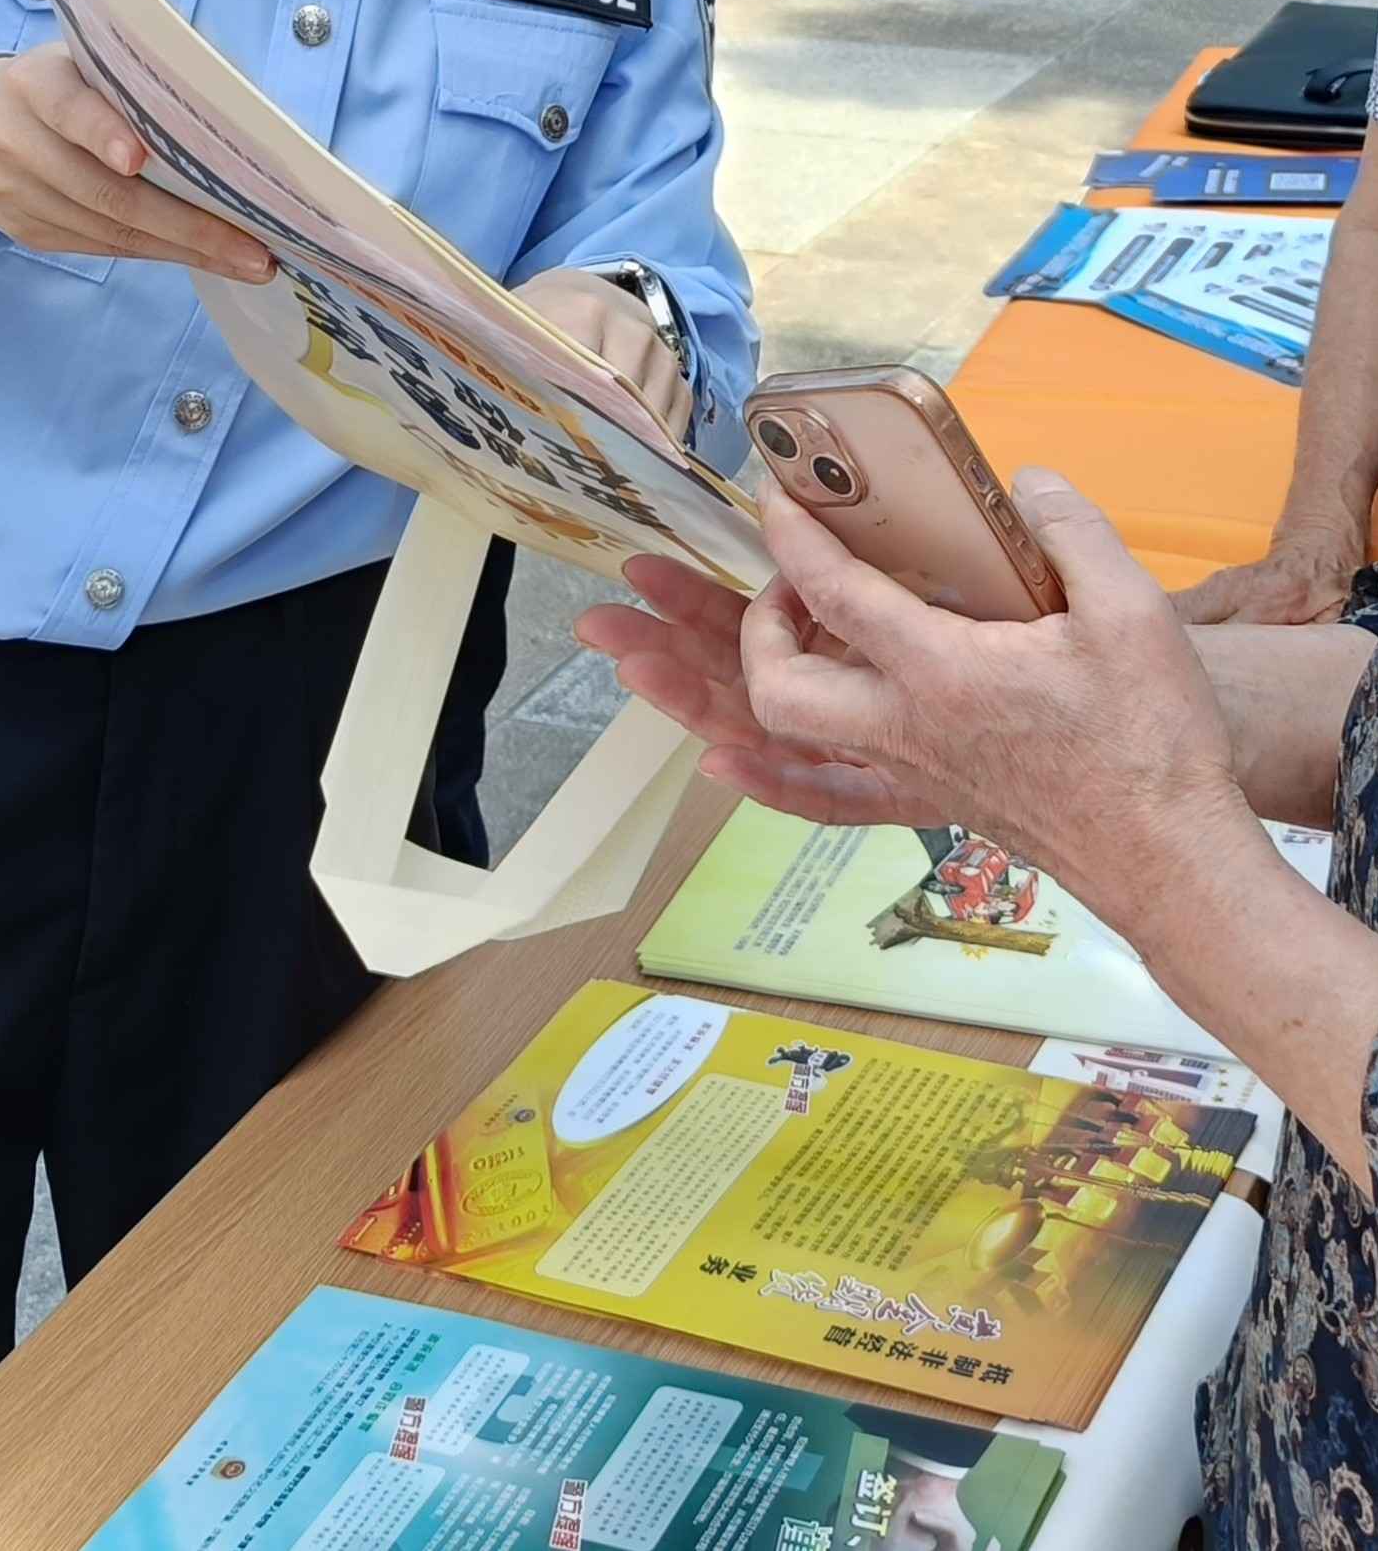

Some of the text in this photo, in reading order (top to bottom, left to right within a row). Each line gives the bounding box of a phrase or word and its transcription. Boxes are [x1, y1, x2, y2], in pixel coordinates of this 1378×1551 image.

[700, 1251, 755, 1286] 业务
[824, 1325, 1013, 1385] 抵制非法经营
